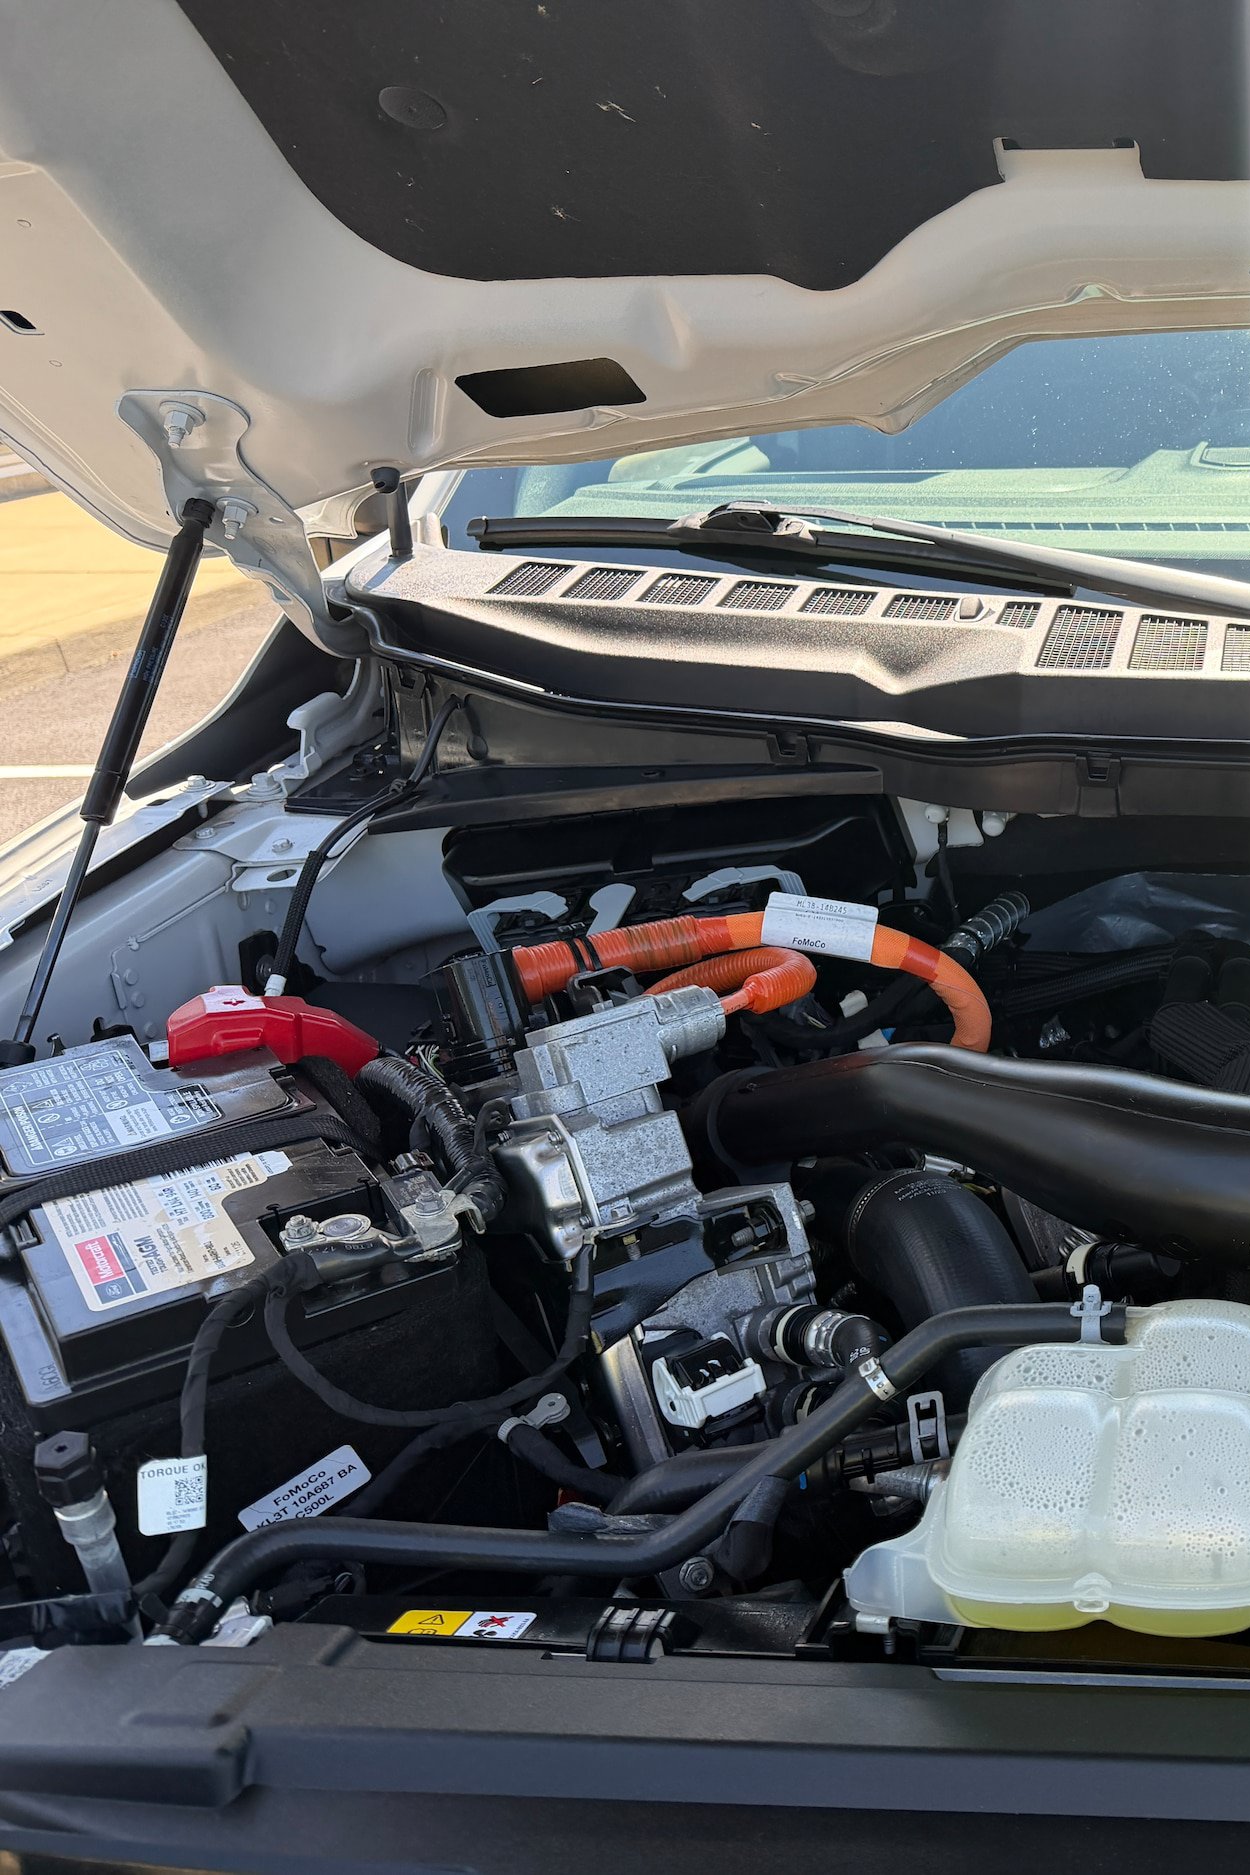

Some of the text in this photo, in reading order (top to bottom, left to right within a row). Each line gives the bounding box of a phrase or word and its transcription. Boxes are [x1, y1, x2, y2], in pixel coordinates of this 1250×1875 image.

[791, 936, 826, 949] FoMoCo
[133, 1235, 161, 1258] AGM
[90, 1240, 115, 1280] Motorcraft
[140, 1465, 189, 1480] TORQUE
[256, 1464, 358, 1529] KL3T 10A687 BA
[273, 1470, 327, 1507] FoMoCo
[295, 1494, 335, 1519] C500L
